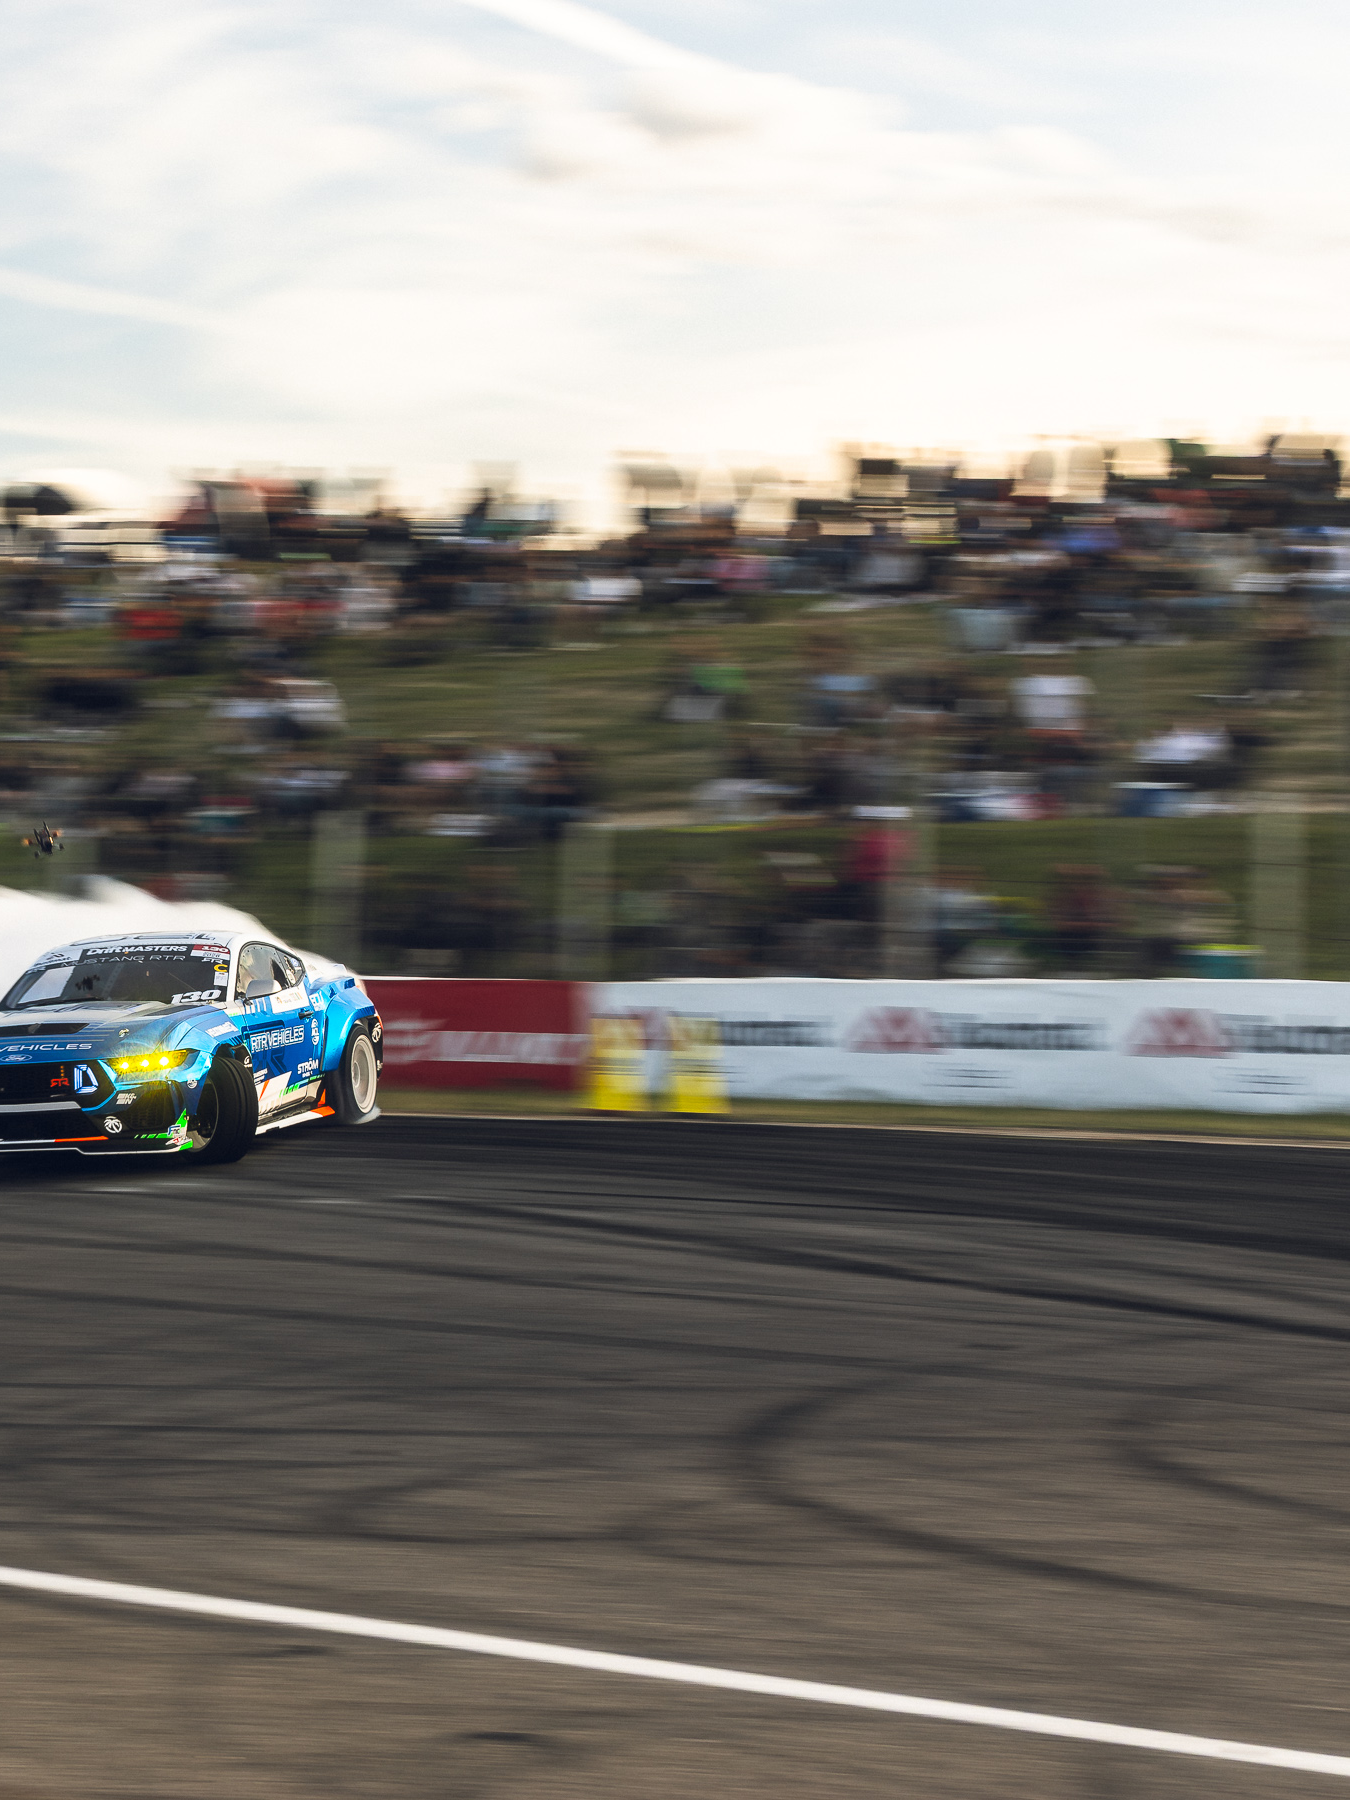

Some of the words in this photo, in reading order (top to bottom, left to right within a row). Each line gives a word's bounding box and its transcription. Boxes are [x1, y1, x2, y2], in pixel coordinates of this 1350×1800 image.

[61, 955, 145, 967] MUSTANG
[213, 964, 229, 973] C
[171, 989, 222, 1005] 130
[251, 1032, 269, 1053] RTR
[268, 1025, 305, 1049] VEHICLES
[297, 1057, 319, 1075] STRÖM
[50, 1078, 70, 1088] RTR
